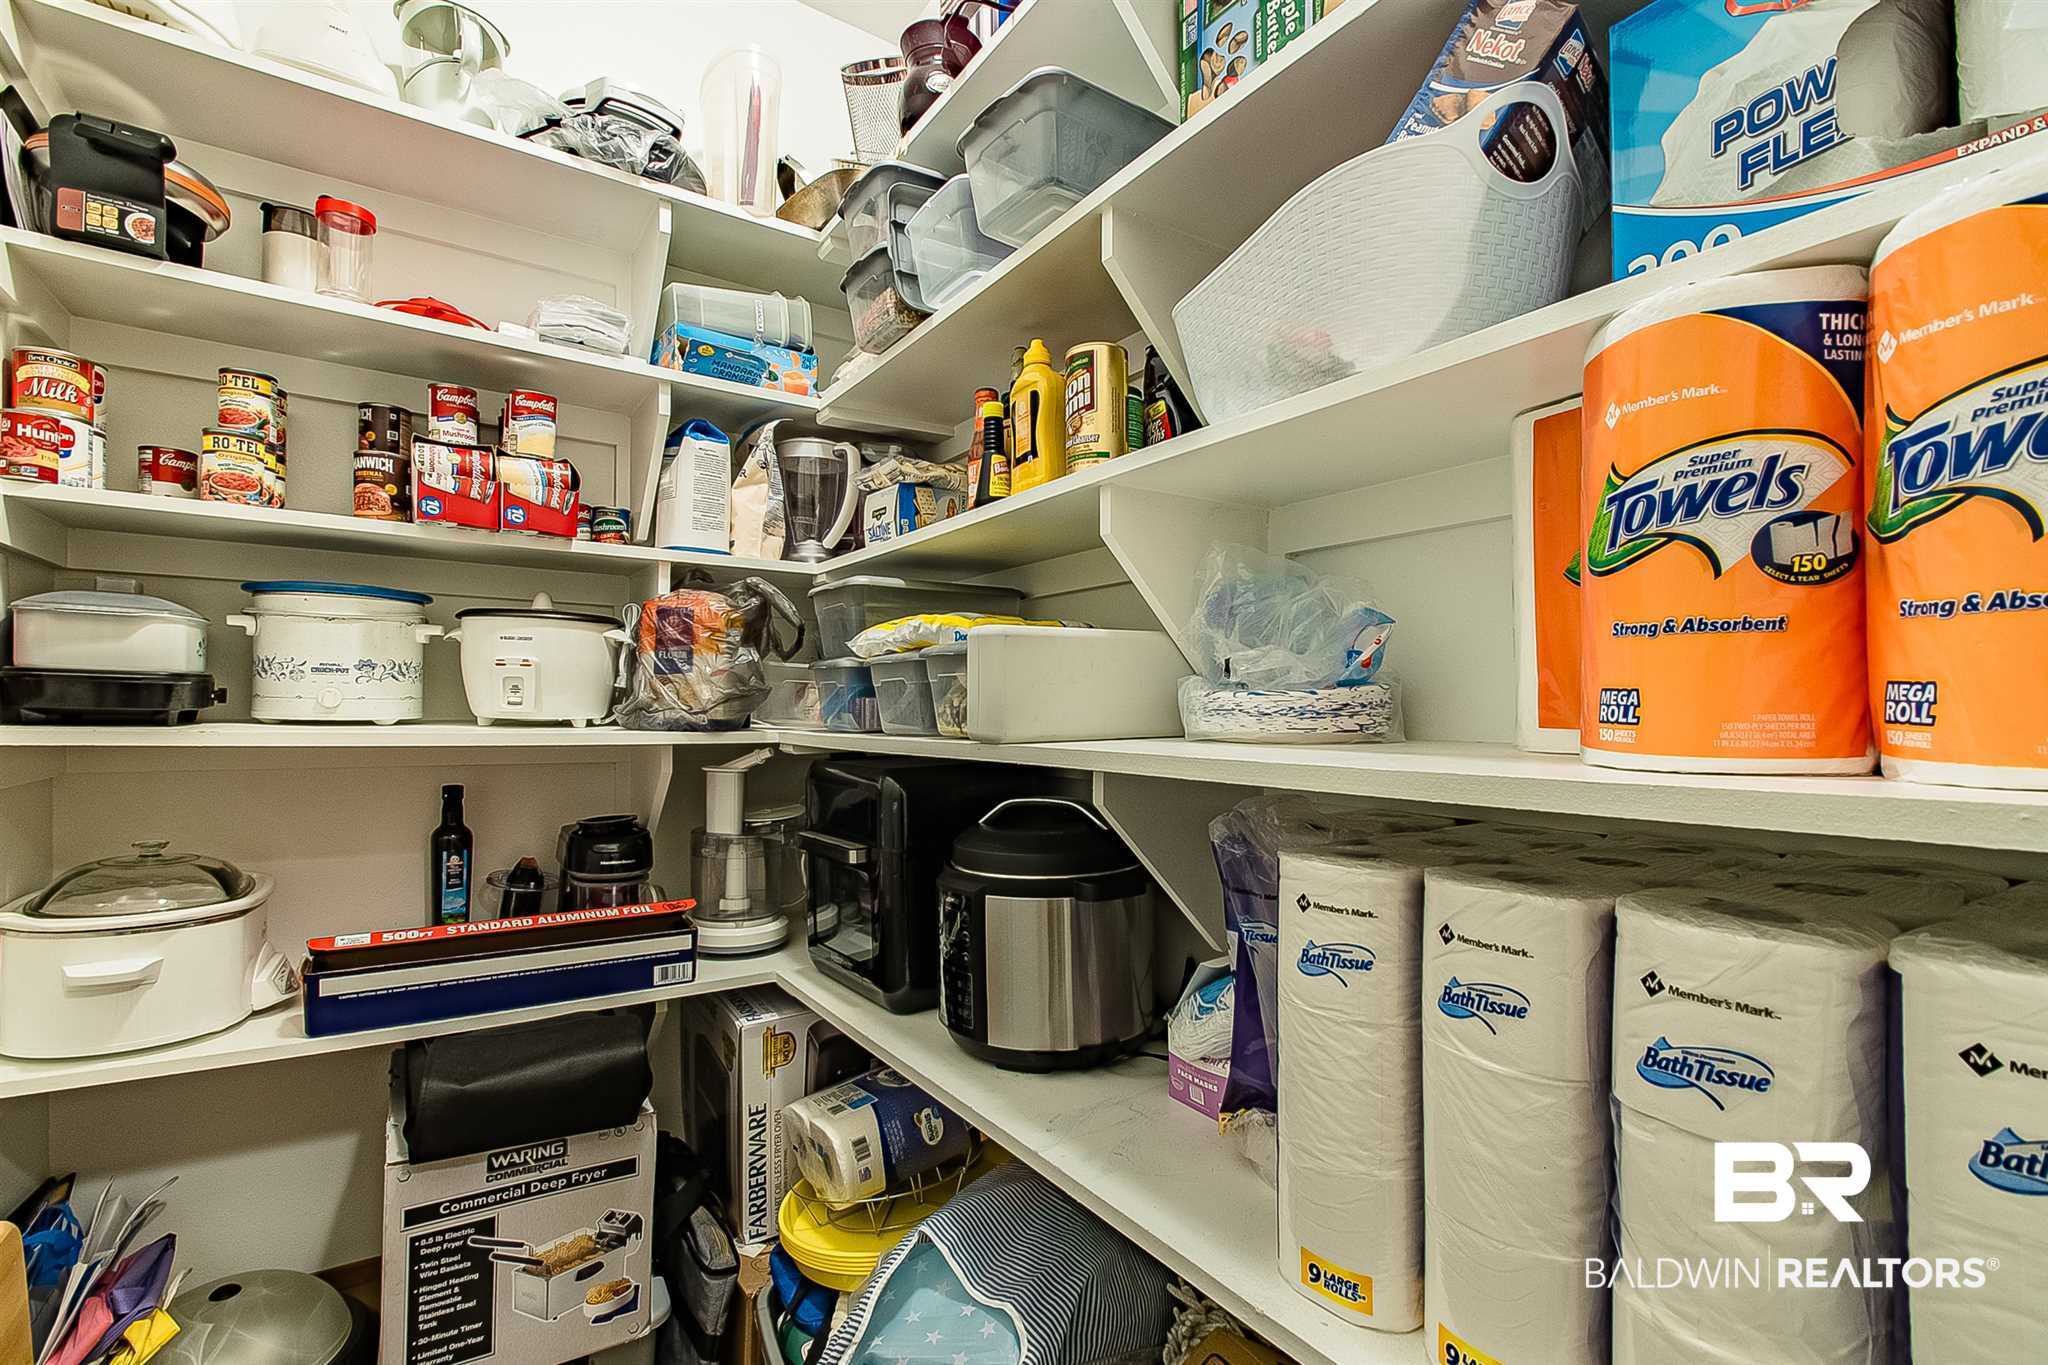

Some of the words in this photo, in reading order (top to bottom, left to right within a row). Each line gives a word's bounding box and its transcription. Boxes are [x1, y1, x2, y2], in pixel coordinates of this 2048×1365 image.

[1266, 0, 1280, 56] Butte
[1466, 29, 1526, 63] Nekot
[1711, 54, 1838, 159] POW
[1957, 123, 2030, 157] EXPAND
[2032, 117, 2047, 132] &
[1899, 308, 1974, 345] Member's
[1979, 292, 2035, 319] Mark
[1823, 334, 1833, 346] &
[27, 353, 45, 362] Best
[46, 356, 78, 369] Choice
[1824, 348, 1863, 361] LASTIN
[711, 359, 763, 379] MANDARIN
[711, 366, 758, 385] ORANGES
[24, 377, 79, 403] Milk
[1066, 372, 1091, 399] on
[1990, 379, 2048, 404] Supe
[1621, 390, 1679, 415] Member's
[1681, 383, 1721, 399] Mark
[212, 436, 260, 455] RO-TEL
[354, 456, 395, 474] ANWICH
[1688, 449, 1743, 468] Super
[1673, 459, 1753, 482] Premium
[426, 500, 440, 515] 10
[1604, 451, 1807, 554] Towels
[512, 508, 524, 523] 10
[1763, 564, 1789, 582] SELECT
[1797, 574, 1820, 583] TEAR
[1823, 562, 1849, 579] SHEETS
[1791, 554, 1828, 573] 150
[1900, 599, 1956, 619] Strong
[1961, 593, 1981, 613] &
[1612, 620, 1659, 638] Strong
[1662, 617, 1678, 634] &
[1680, 614, 1788, 634] Absorbent
[1600, 690, 1639, 706] MEGA
[1886, 683, 1936, 702] MEGA
[1599, 705, 1639, 723] ROLL
[1885, 701, 1934, 724] ROLL
[446, 916, 534, 936] STANDARD
[537, 906, 620, 926] ALUMINUM
[622, 902, 656, 916] FOIL
[1313, 901, 1350, 917] Member's
[1351, 909, 1374, 919] Mark
[1457, 933, 1500, 953] Member's
[1501, 944, 1529, 958] Mark
[1667, 984, 1732, 1011] Member's
[1735, 1001, 1776, 1020] Mark
[1177, 1067, 1193, 1082] FACE
[1193, 1076, 1219, 1093] MASKS
[774, 1109, 783, 1133] OVEN
[489, 1142, 565, 1169] WARING
[485, 1157, 569, 1184] COMMERCIAL
[748, 1102, 768, 1241] FARBERWARE
[439, 1184, 526, 1215] Commercial
[530, 1175, 567, 1193] Deep
[571, 1166, 608, 1186] Fryer
[445, 1227, 476, 1240] Electric
[420, 1246, 442, 1256] Deep
[443, 1239, 465, 1251] Fryer
[419, 1269, 439, 1280] Wire
[440, 1261, 472, 1275] Baskets
[420, 1260, 439, 1270] Twin
[419, 1280, 448, 1294] Hinged
[449, 1272, 480, 1287] Heating
[1308, 1263, 1321, 1283] 9
[1323, 1269, 1361, 1293] LARGE
[418, 1295, 462, 1313] Removable
[419, 1289, 452, 1303] Element
[418, 1306, 455, 1322] Stainless
[456, 1299, 478, 1311] Steel
[417, 1328, 459, 1346] 30-Minute
[460, 1321, 484, 1334] Timer
[418, 1320, 438, 1332] Tank
[417, 1345, 448, 1361] Limited
[448, 1335, 485, 1351] One-Year
[1445, 1342, 1460, 1365] 9
